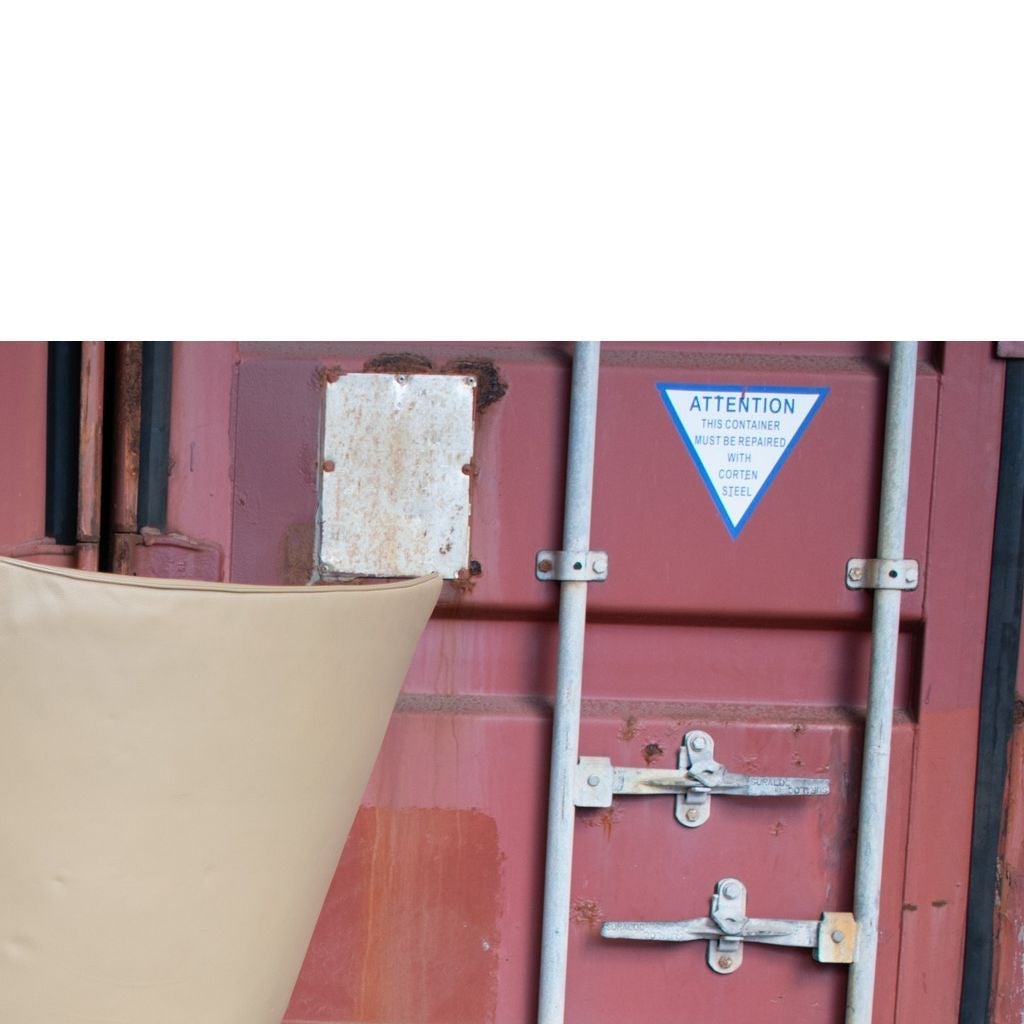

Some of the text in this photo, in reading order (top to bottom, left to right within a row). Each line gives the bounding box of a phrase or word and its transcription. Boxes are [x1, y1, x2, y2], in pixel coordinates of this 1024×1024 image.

[689, 395, 795, 414] ATTENTION
[702, 418, 780, 431] THIS CONTAINER
[695, 435, 786, 448] MUST BE REPAIRED
[727, 453, 751, 462] WITH
[718, 469, 758, 480] CORTEN
[722, 486, 752, 497] STEEL
